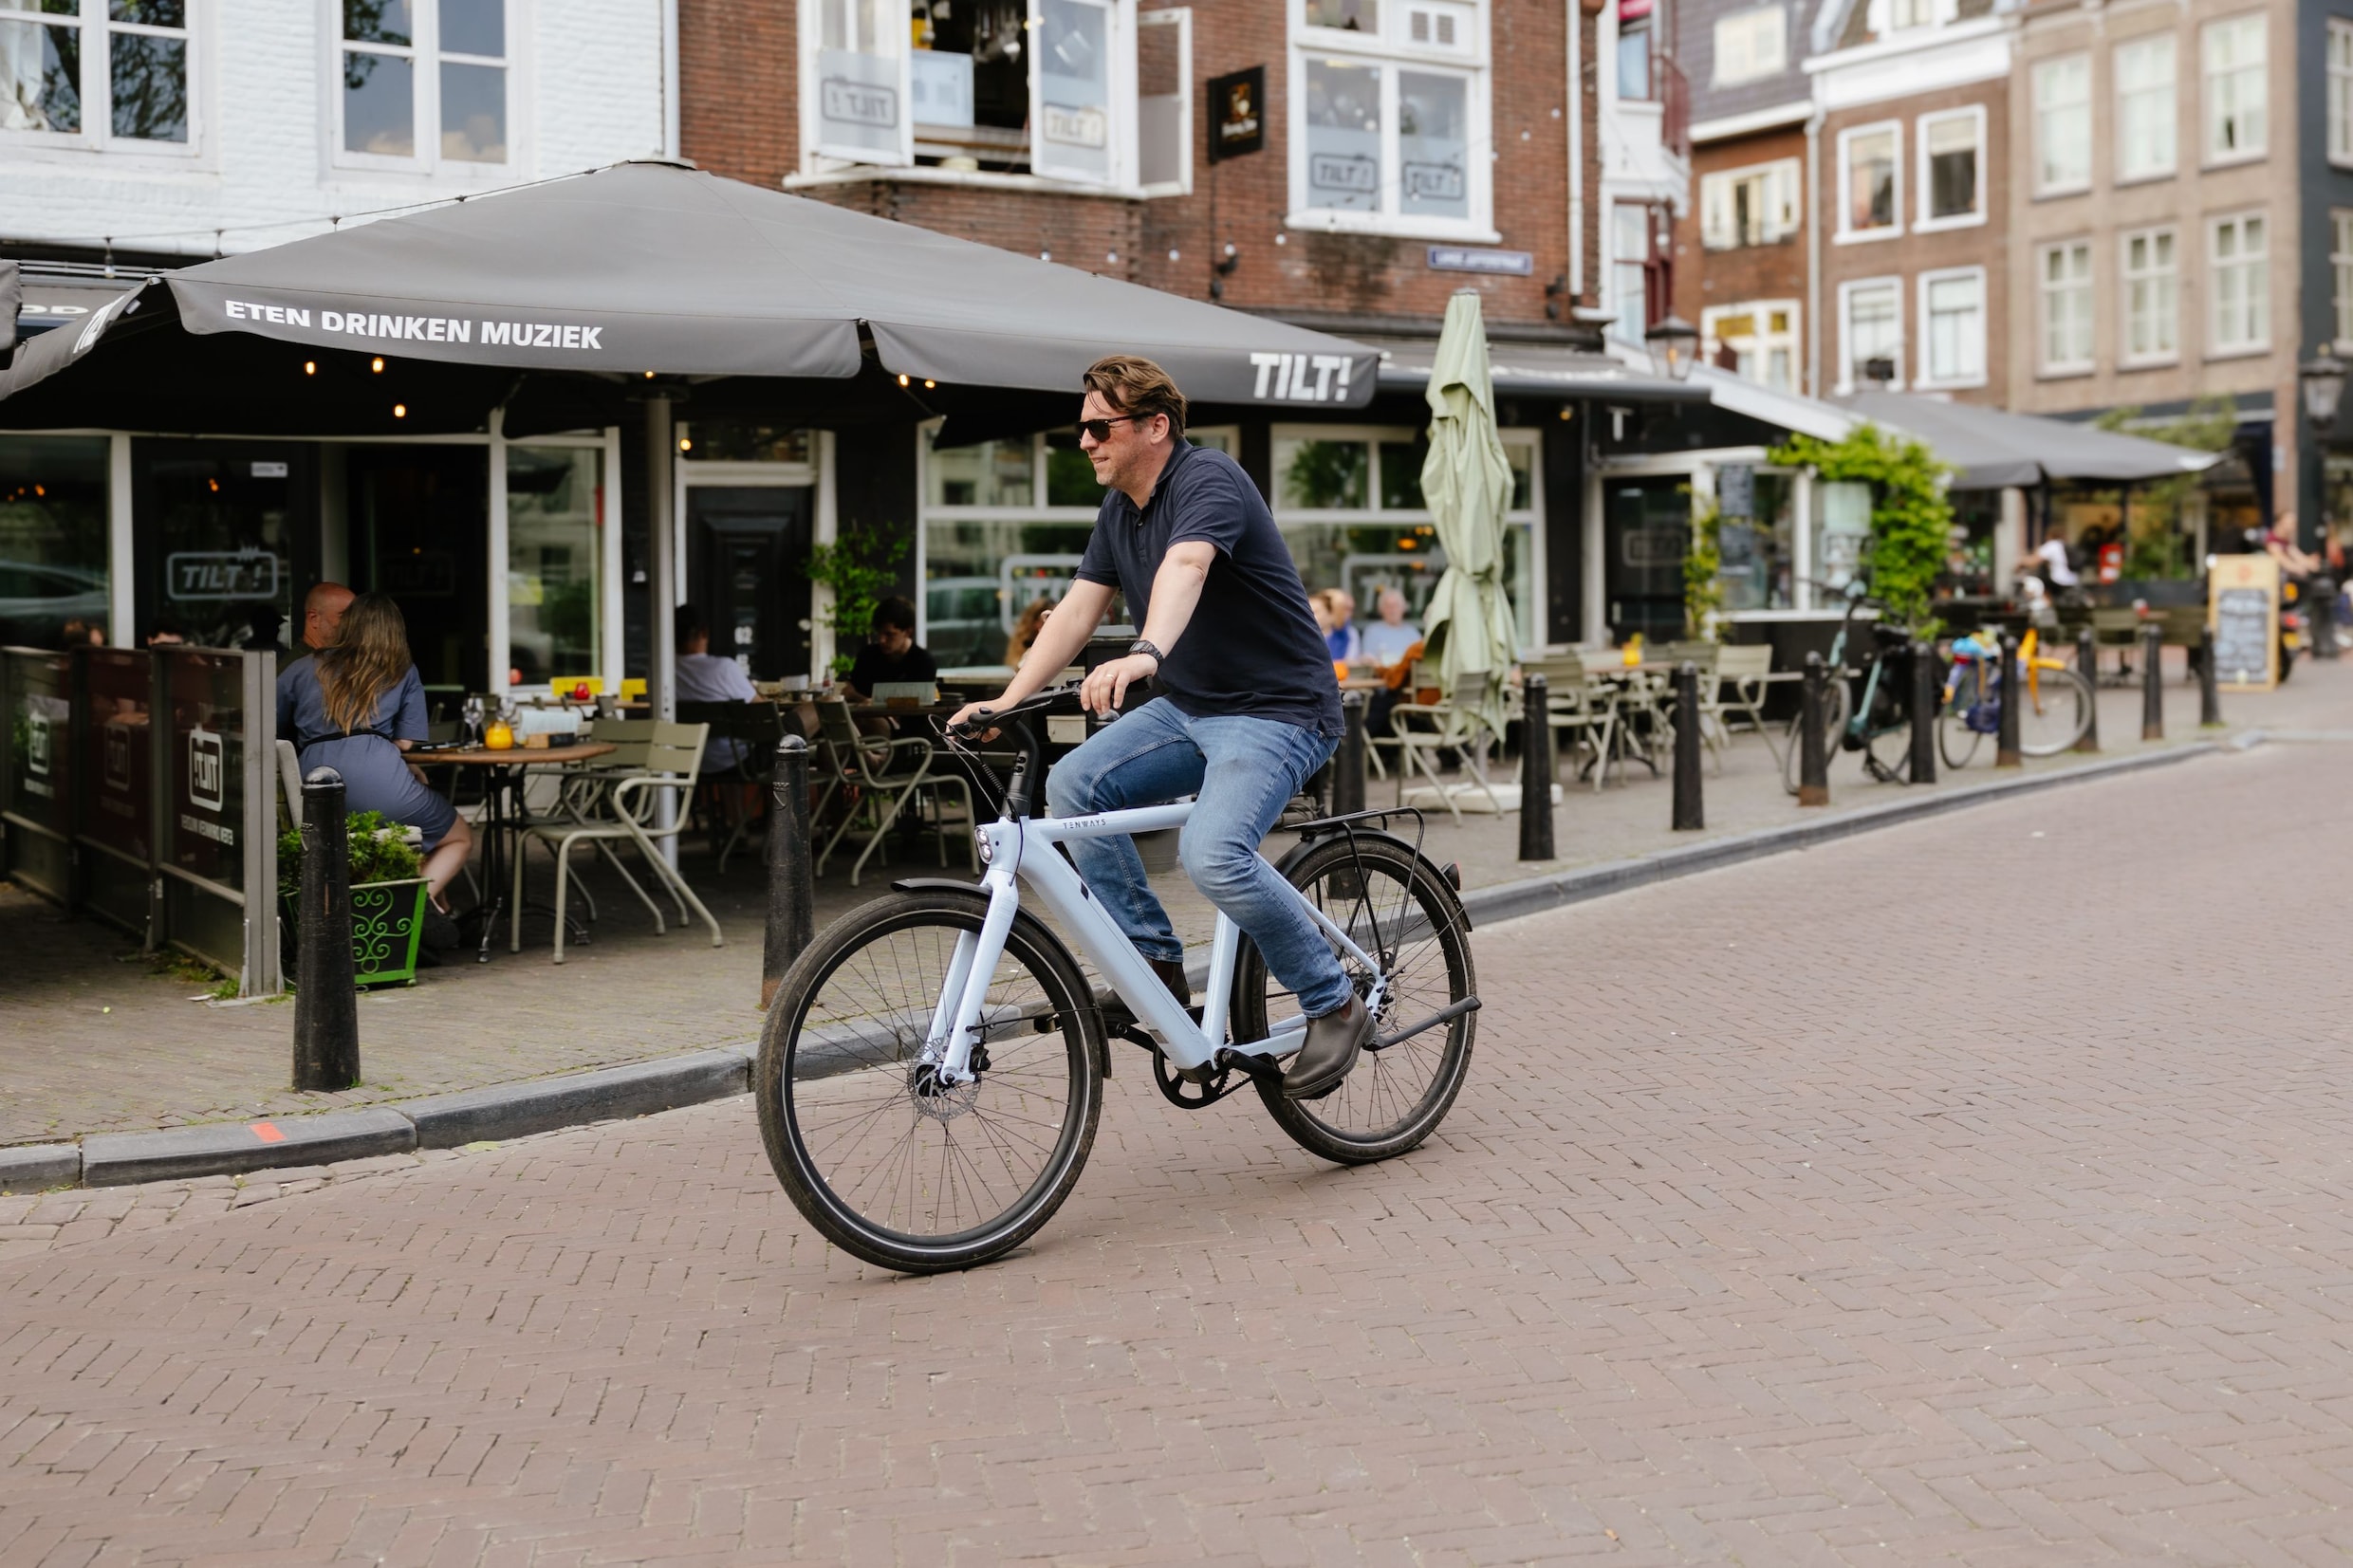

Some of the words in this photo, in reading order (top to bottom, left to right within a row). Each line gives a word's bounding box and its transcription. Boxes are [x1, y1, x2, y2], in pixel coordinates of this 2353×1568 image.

[225, 300, 310, 327] ETEN
[321, 310, 472, 342] DRINKEN
[480, 321, 603, 349] MUZIEK
[1250, 352, 1353, 402] TILT!
[1063, 819, 1106, 829] TENWAYS
